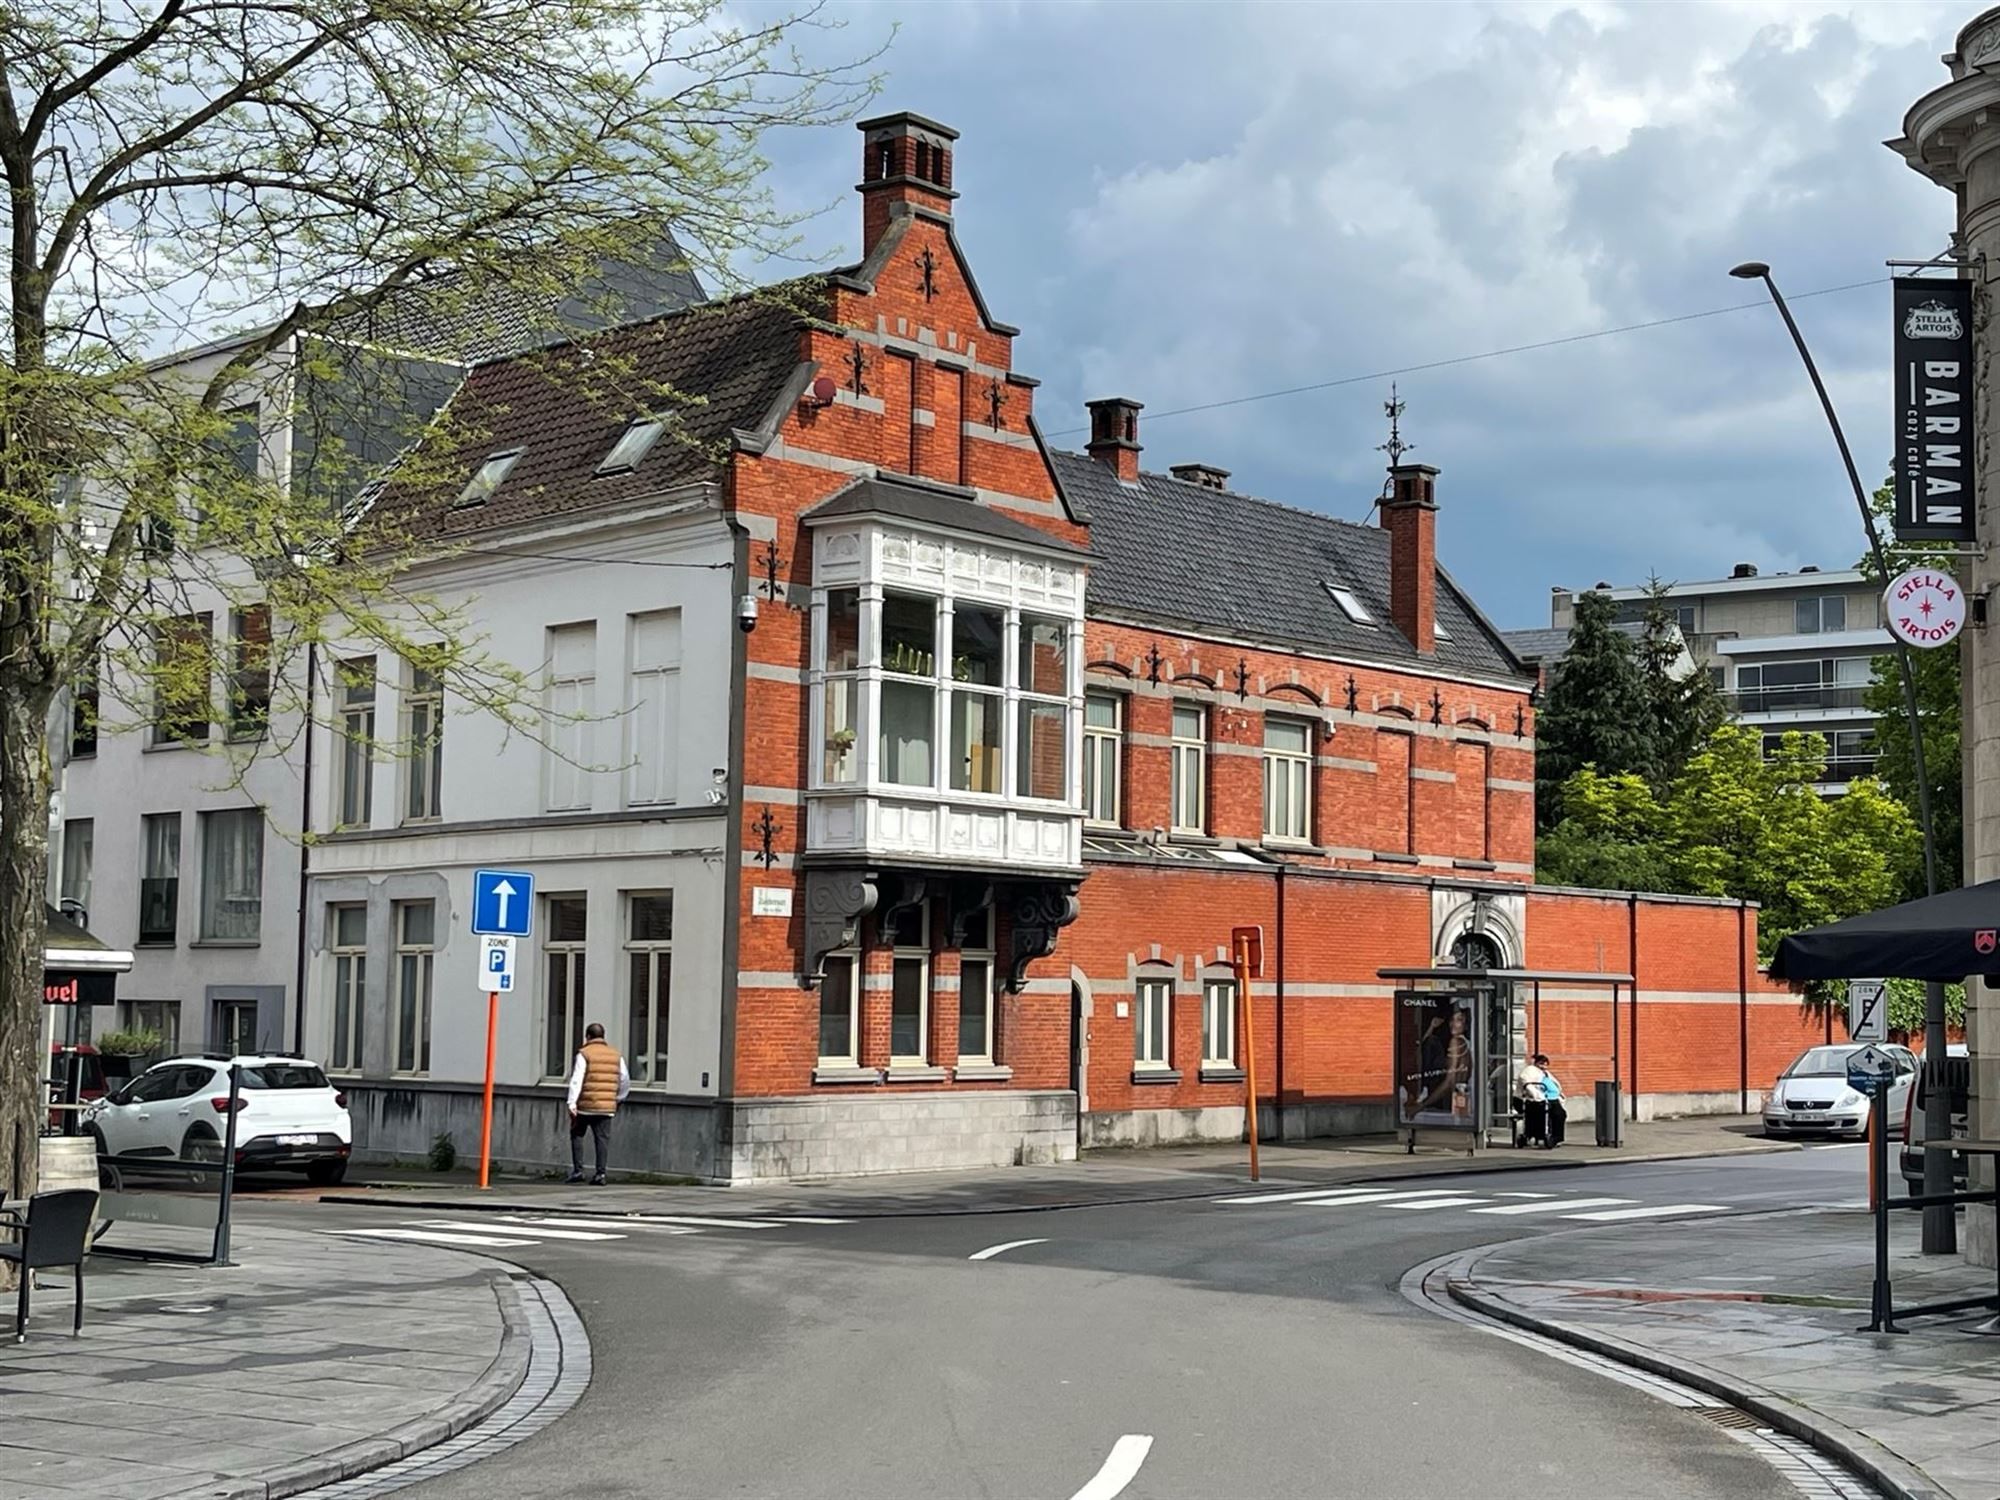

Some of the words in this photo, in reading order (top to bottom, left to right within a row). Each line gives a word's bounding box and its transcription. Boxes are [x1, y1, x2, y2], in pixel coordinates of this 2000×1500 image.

[1915, 315, 1952, 323] STELLA
[1914, 324, 1953, 332] ARTOIS
[1924, 361, 1962, 524] BARMAN
[1897, 575, 1956, 601] STELLA
[1898, 617, 1957, 641] ARTOIS
[487, 938, 510, 947] ZONE
[45, 978, 78, 1003] vel
[1403, 999, 1438, 1008] CHANEL
